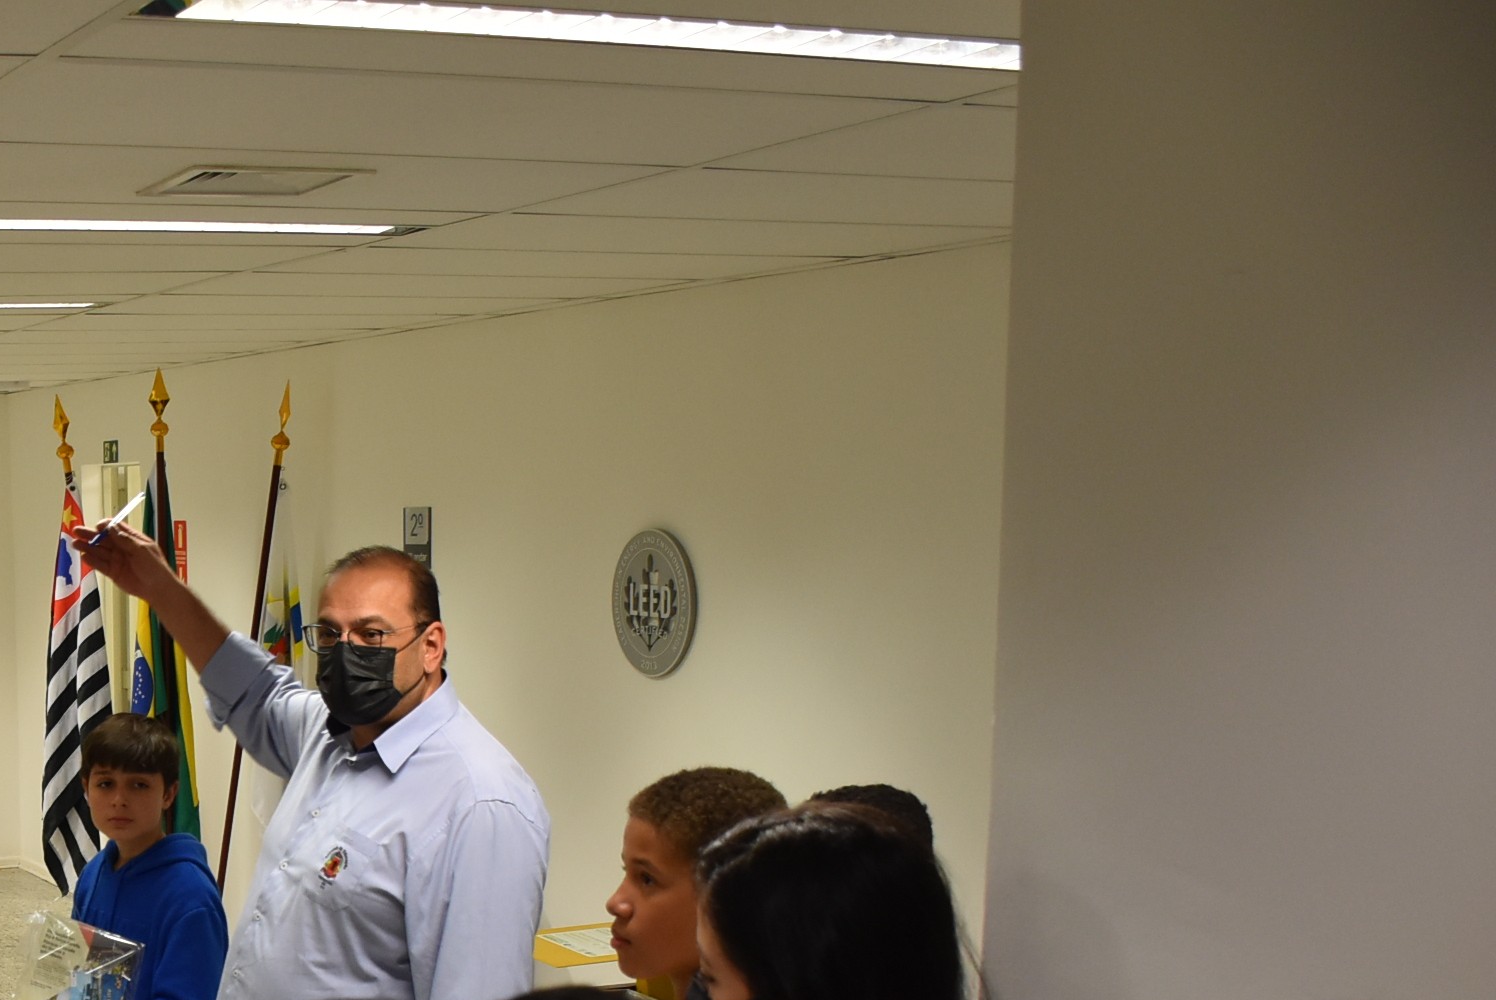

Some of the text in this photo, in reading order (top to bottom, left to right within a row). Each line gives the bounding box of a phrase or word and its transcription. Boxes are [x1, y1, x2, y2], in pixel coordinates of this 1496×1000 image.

[643, 536, 655, 544] AND
[629, 582, 671, 619] LEED
[631, 625, 668, 640] CERTIFIED
